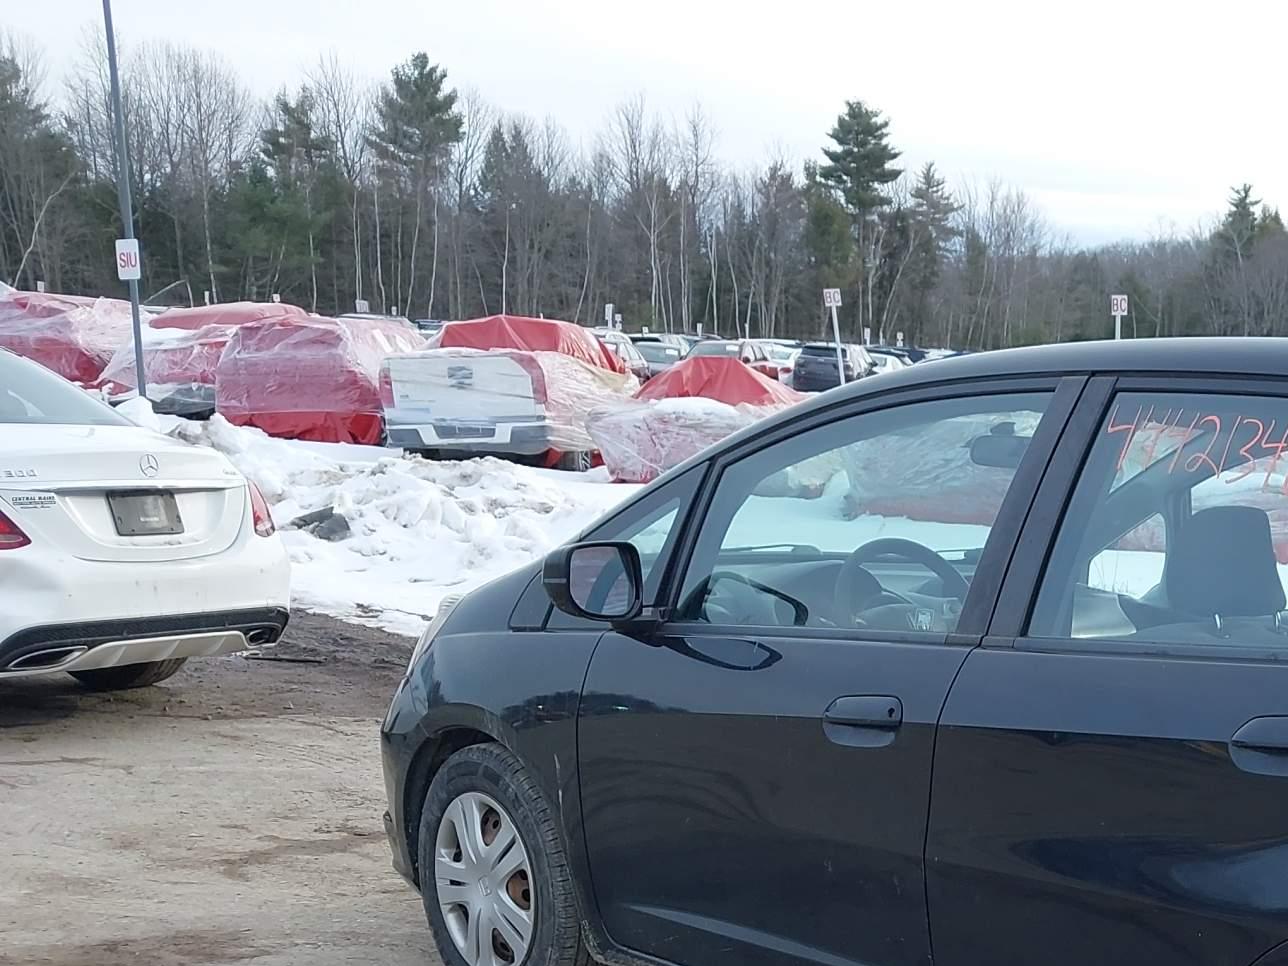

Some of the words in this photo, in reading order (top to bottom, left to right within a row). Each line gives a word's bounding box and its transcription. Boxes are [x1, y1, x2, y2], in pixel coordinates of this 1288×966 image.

[119, 251, 138, 269] SIU
[824, 290, 841, 304] BC
[1112, 297, 1127, 313] BC
